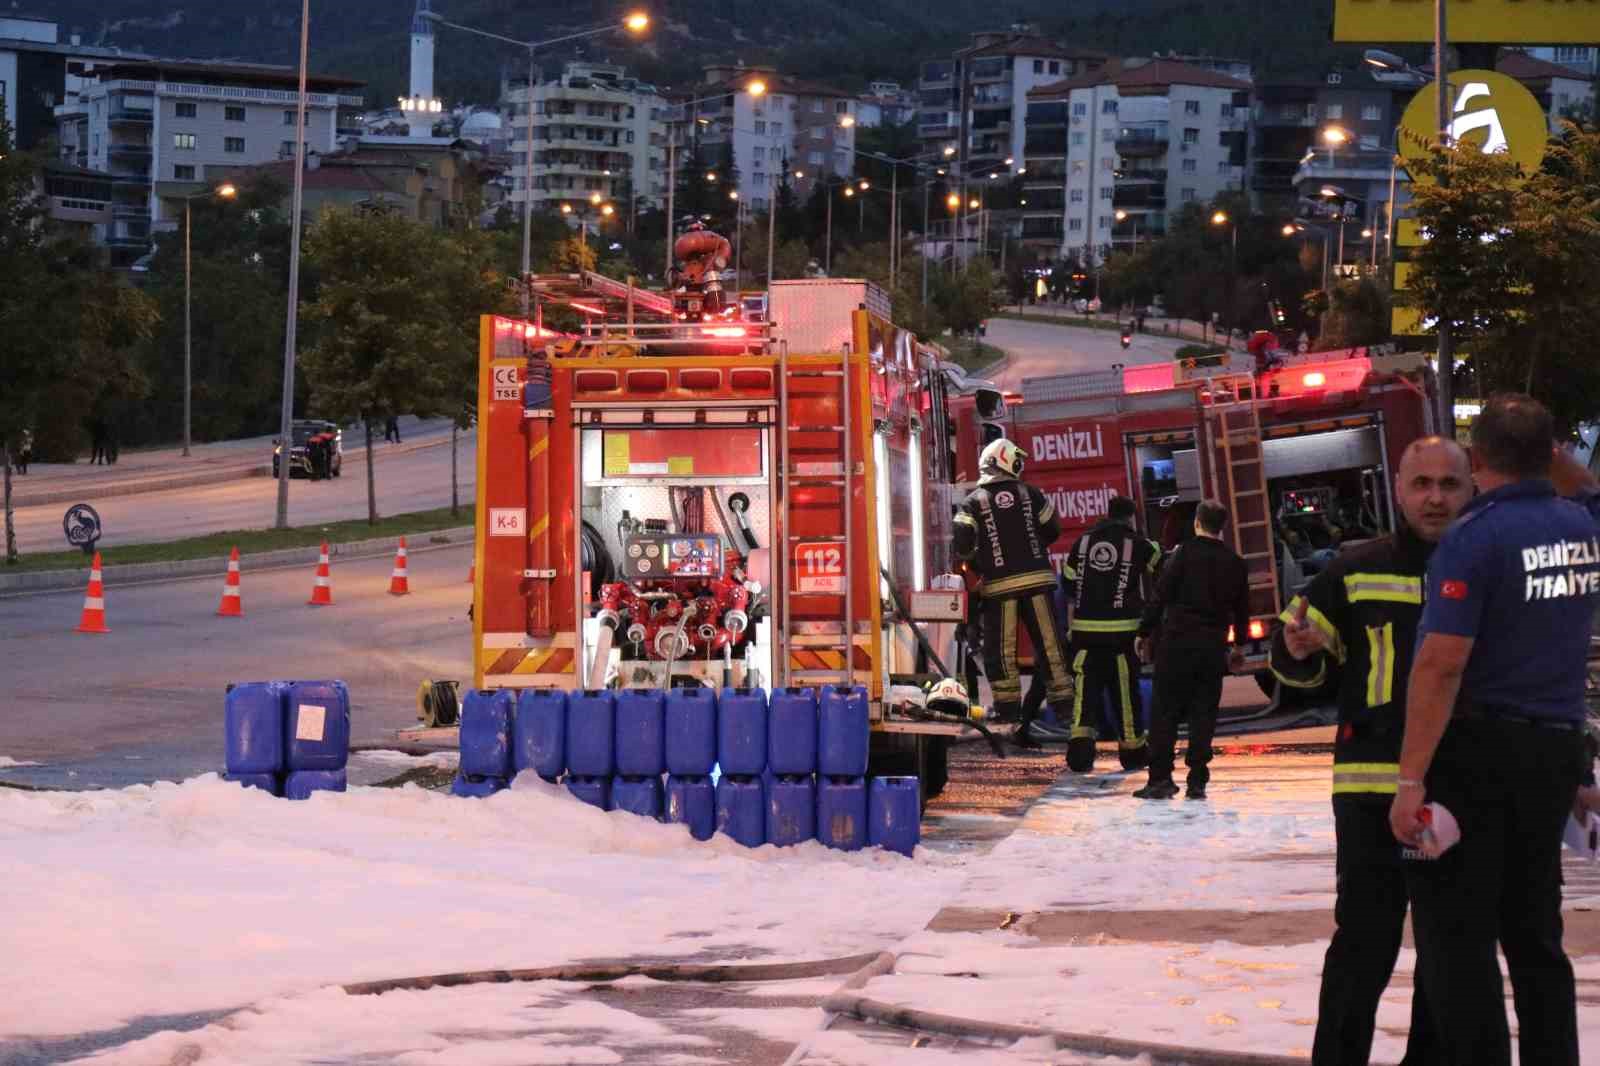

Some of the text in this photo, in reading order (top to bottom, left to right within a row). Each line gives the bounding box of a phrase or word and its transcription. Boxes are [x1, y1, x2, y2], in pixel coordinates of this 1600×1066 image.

[496, 389, 518, 398] TSE
[1032, 424, 1104, 462] DENİZLİ
[497, 515, 518, 529] K-6
[804, 548, 841, 574] 112
[1521, 536, 1600, 572] DENİZLİ
[1525, 568, 1600, 602] İTFAİYE
